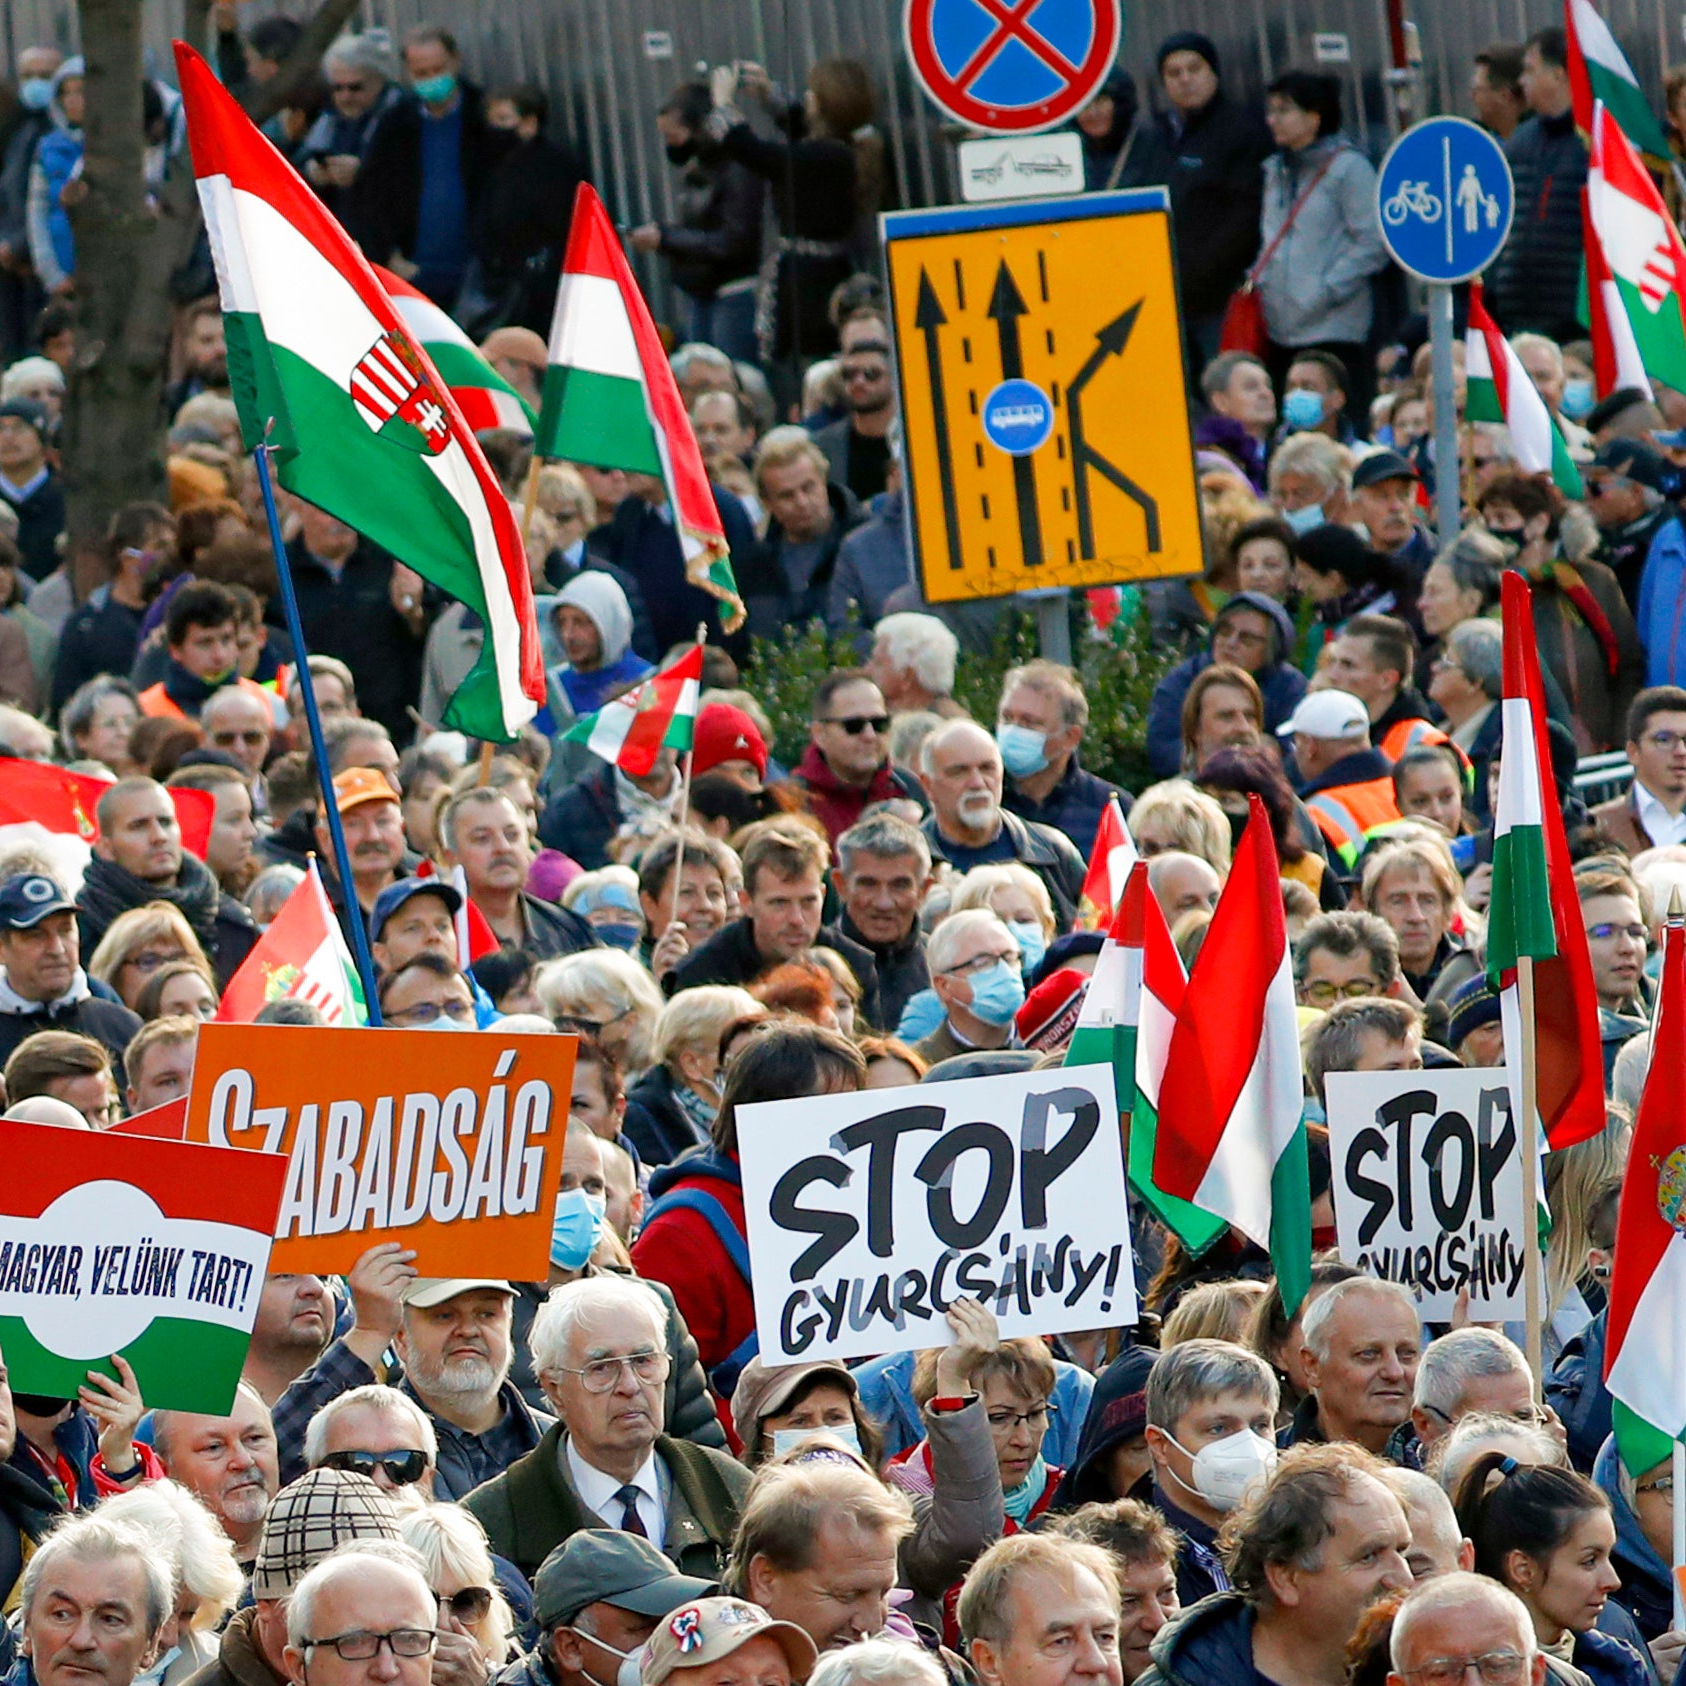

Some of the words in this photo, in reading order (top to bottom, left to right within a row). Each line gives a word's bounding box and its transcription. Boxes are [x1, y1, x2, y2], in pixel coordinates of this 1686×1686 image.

[769, 1087, 1101, 1283] STOP
[1345, 1087, 1517, 1247] STOP
[90, 1237, 183, 1299] VELÜNK
[188, 1250, 254, 1312] TART!
[780, 1233, 1123, 1356] GYURCSÁNY!
